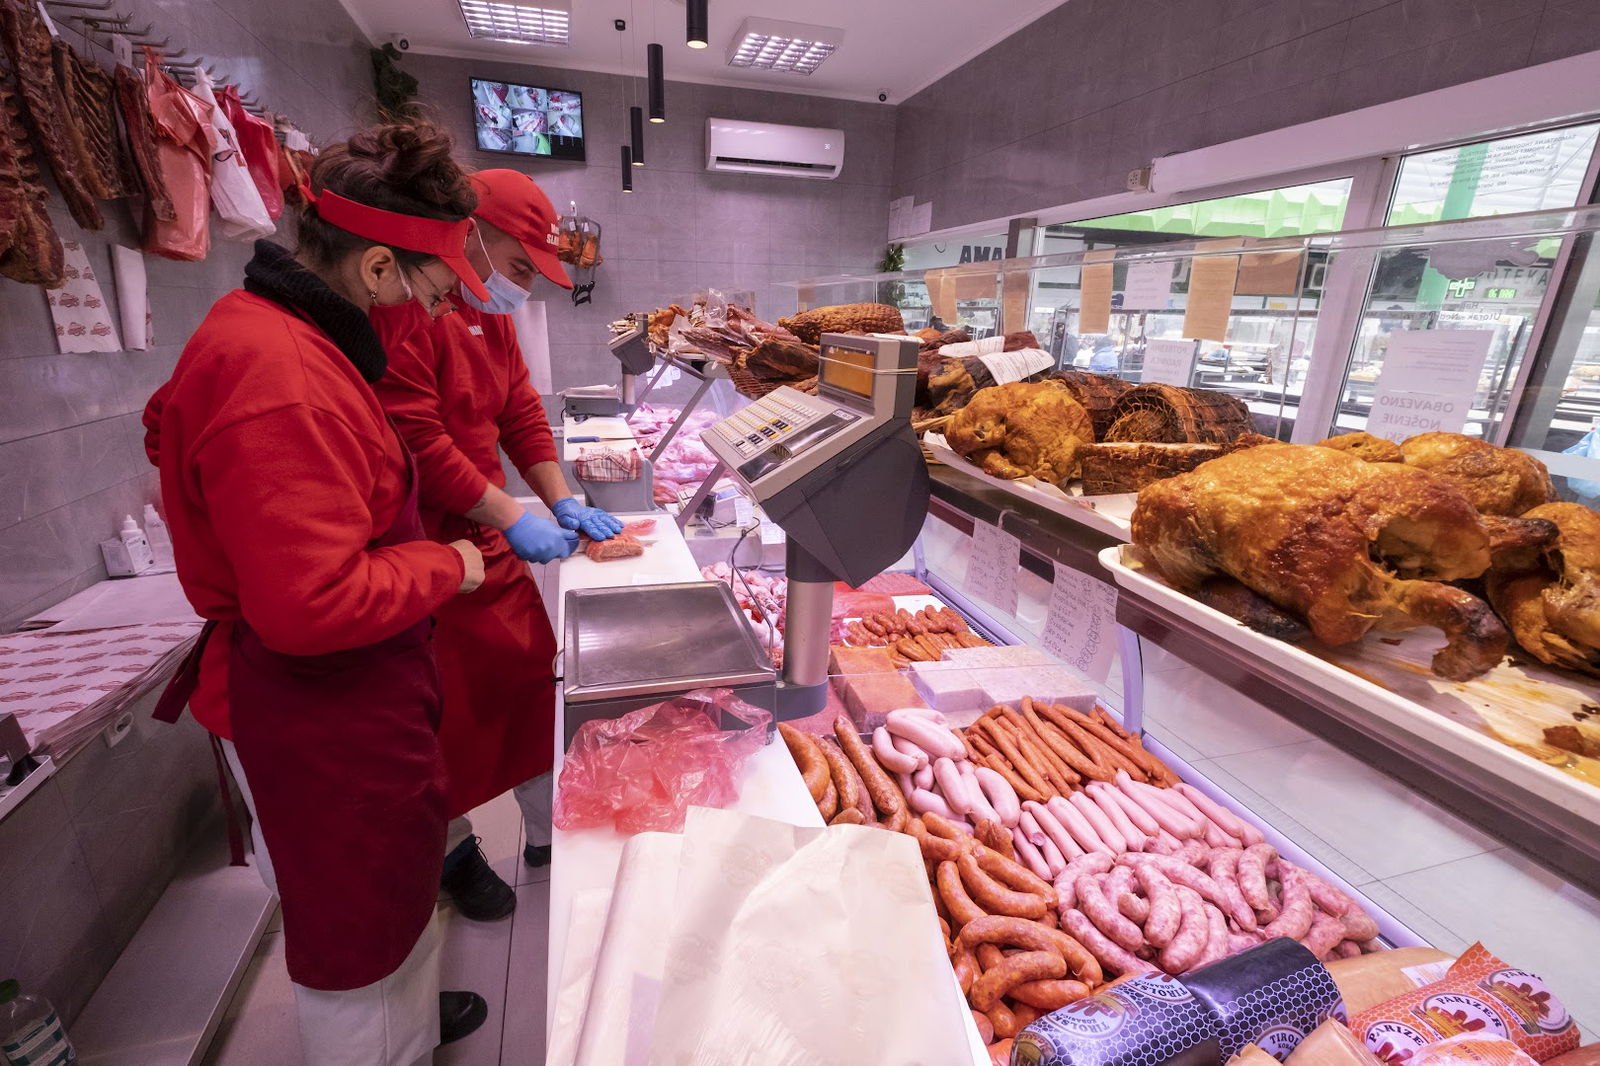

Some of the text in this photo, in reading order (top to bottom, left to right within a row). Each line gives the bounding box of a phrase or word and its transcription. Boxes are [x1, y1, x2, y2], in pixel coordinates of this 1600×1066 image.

[1134, 982, 1187, 998] TIROLSK
[1436, 996, 1503, 1028] PARIZER
[1270, 1032, 1300, 1045] TIROL
[1368, 1024, 1424, 1046] PARIZE
